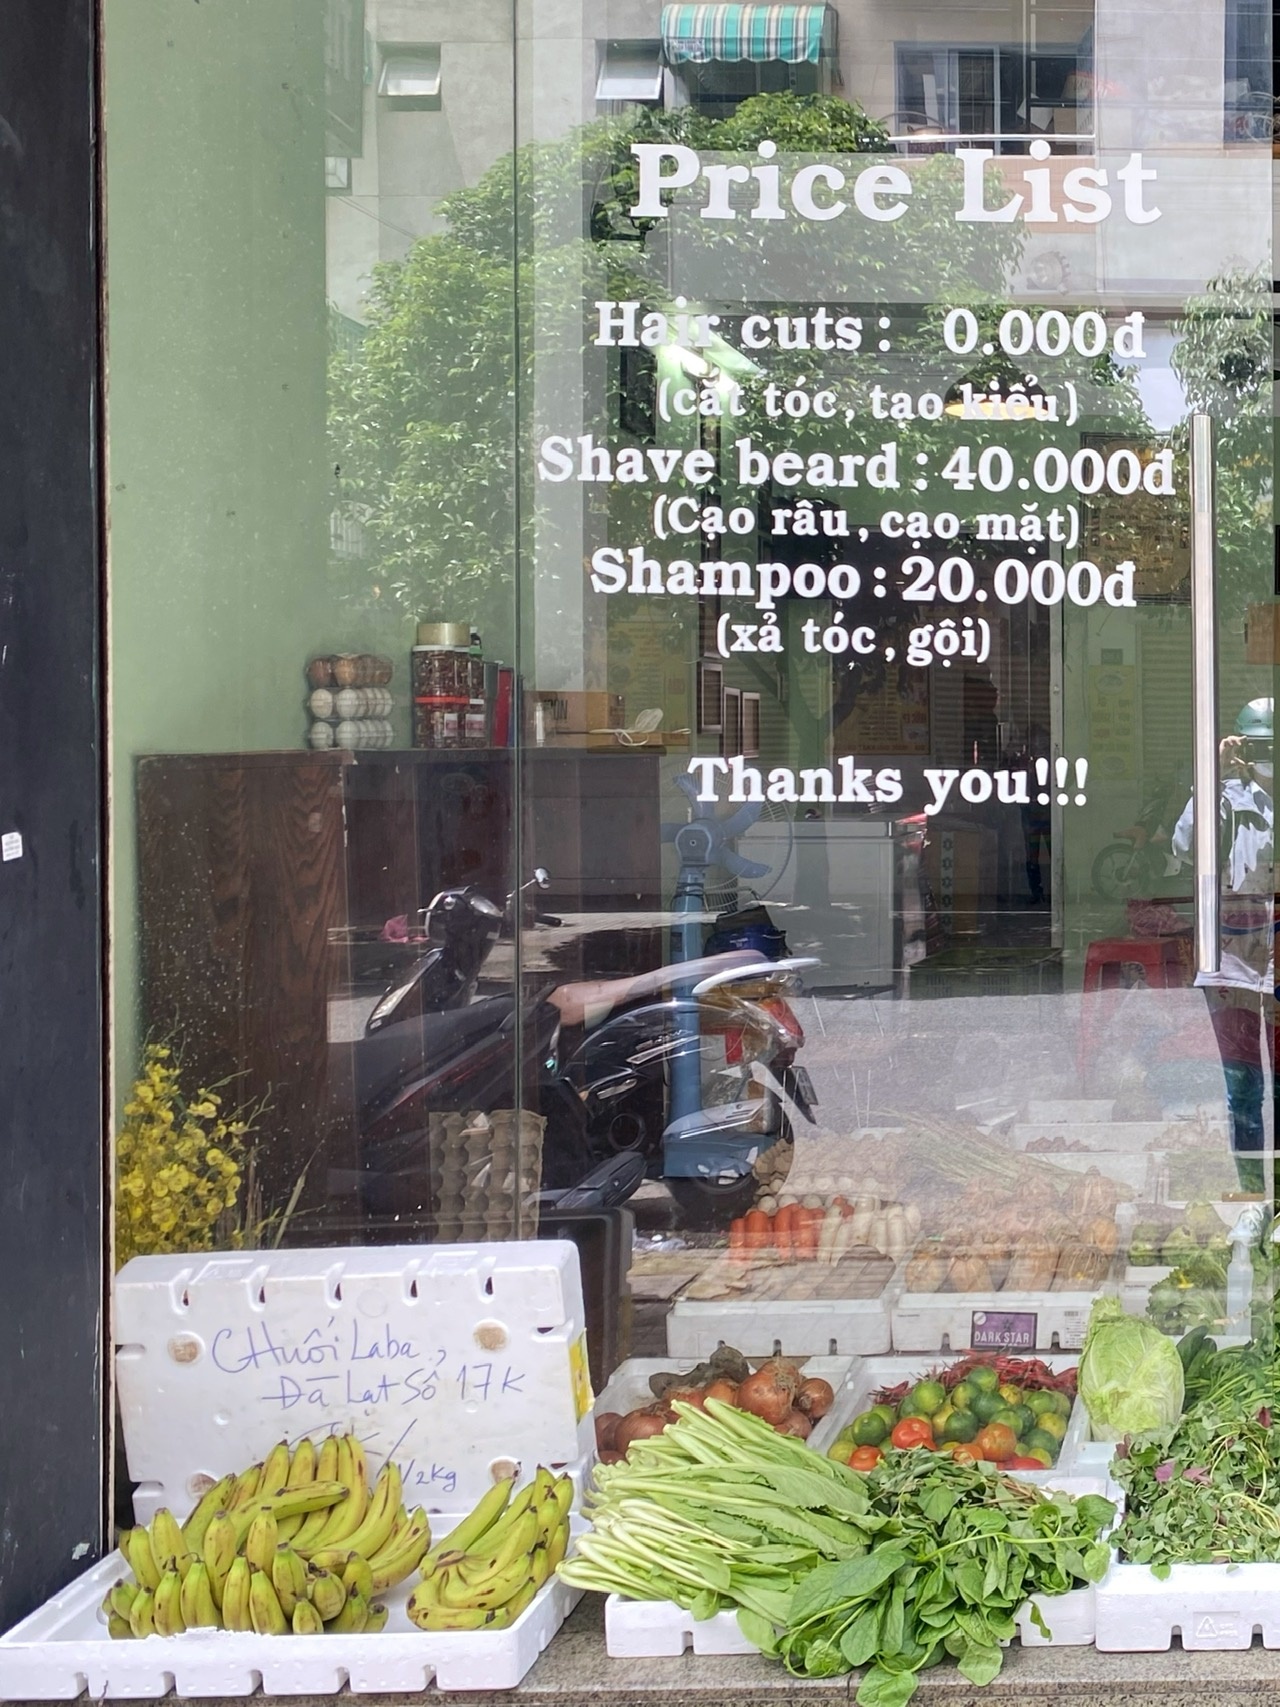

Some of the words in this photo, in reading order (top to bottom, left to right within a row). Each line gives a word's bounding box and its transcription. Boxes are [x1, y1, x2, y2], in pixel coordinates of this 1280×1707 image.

[629, 140, 913, 222] Price
[955, 139, 1163, 225] List
[594, 296, 720, 347] Hair
[960, 374, 1077, 427] kiểu)
[538, 434, 716, 484] Shave
[653, 494, 755, 541] (Cạo
[880, 510, 960, 550] cạo
[976, 502, 1079, 556] mặt)
[717, 611, 784, 659] (xả
[906, 617, 991, 668] gội)
[687, 755, 904, 803] Thanks
[923, 757, 1089, 816] you!!!
[974, 1330, 1001, 1343] DARK
[1003, 1331, 1030, 1345] STAR
